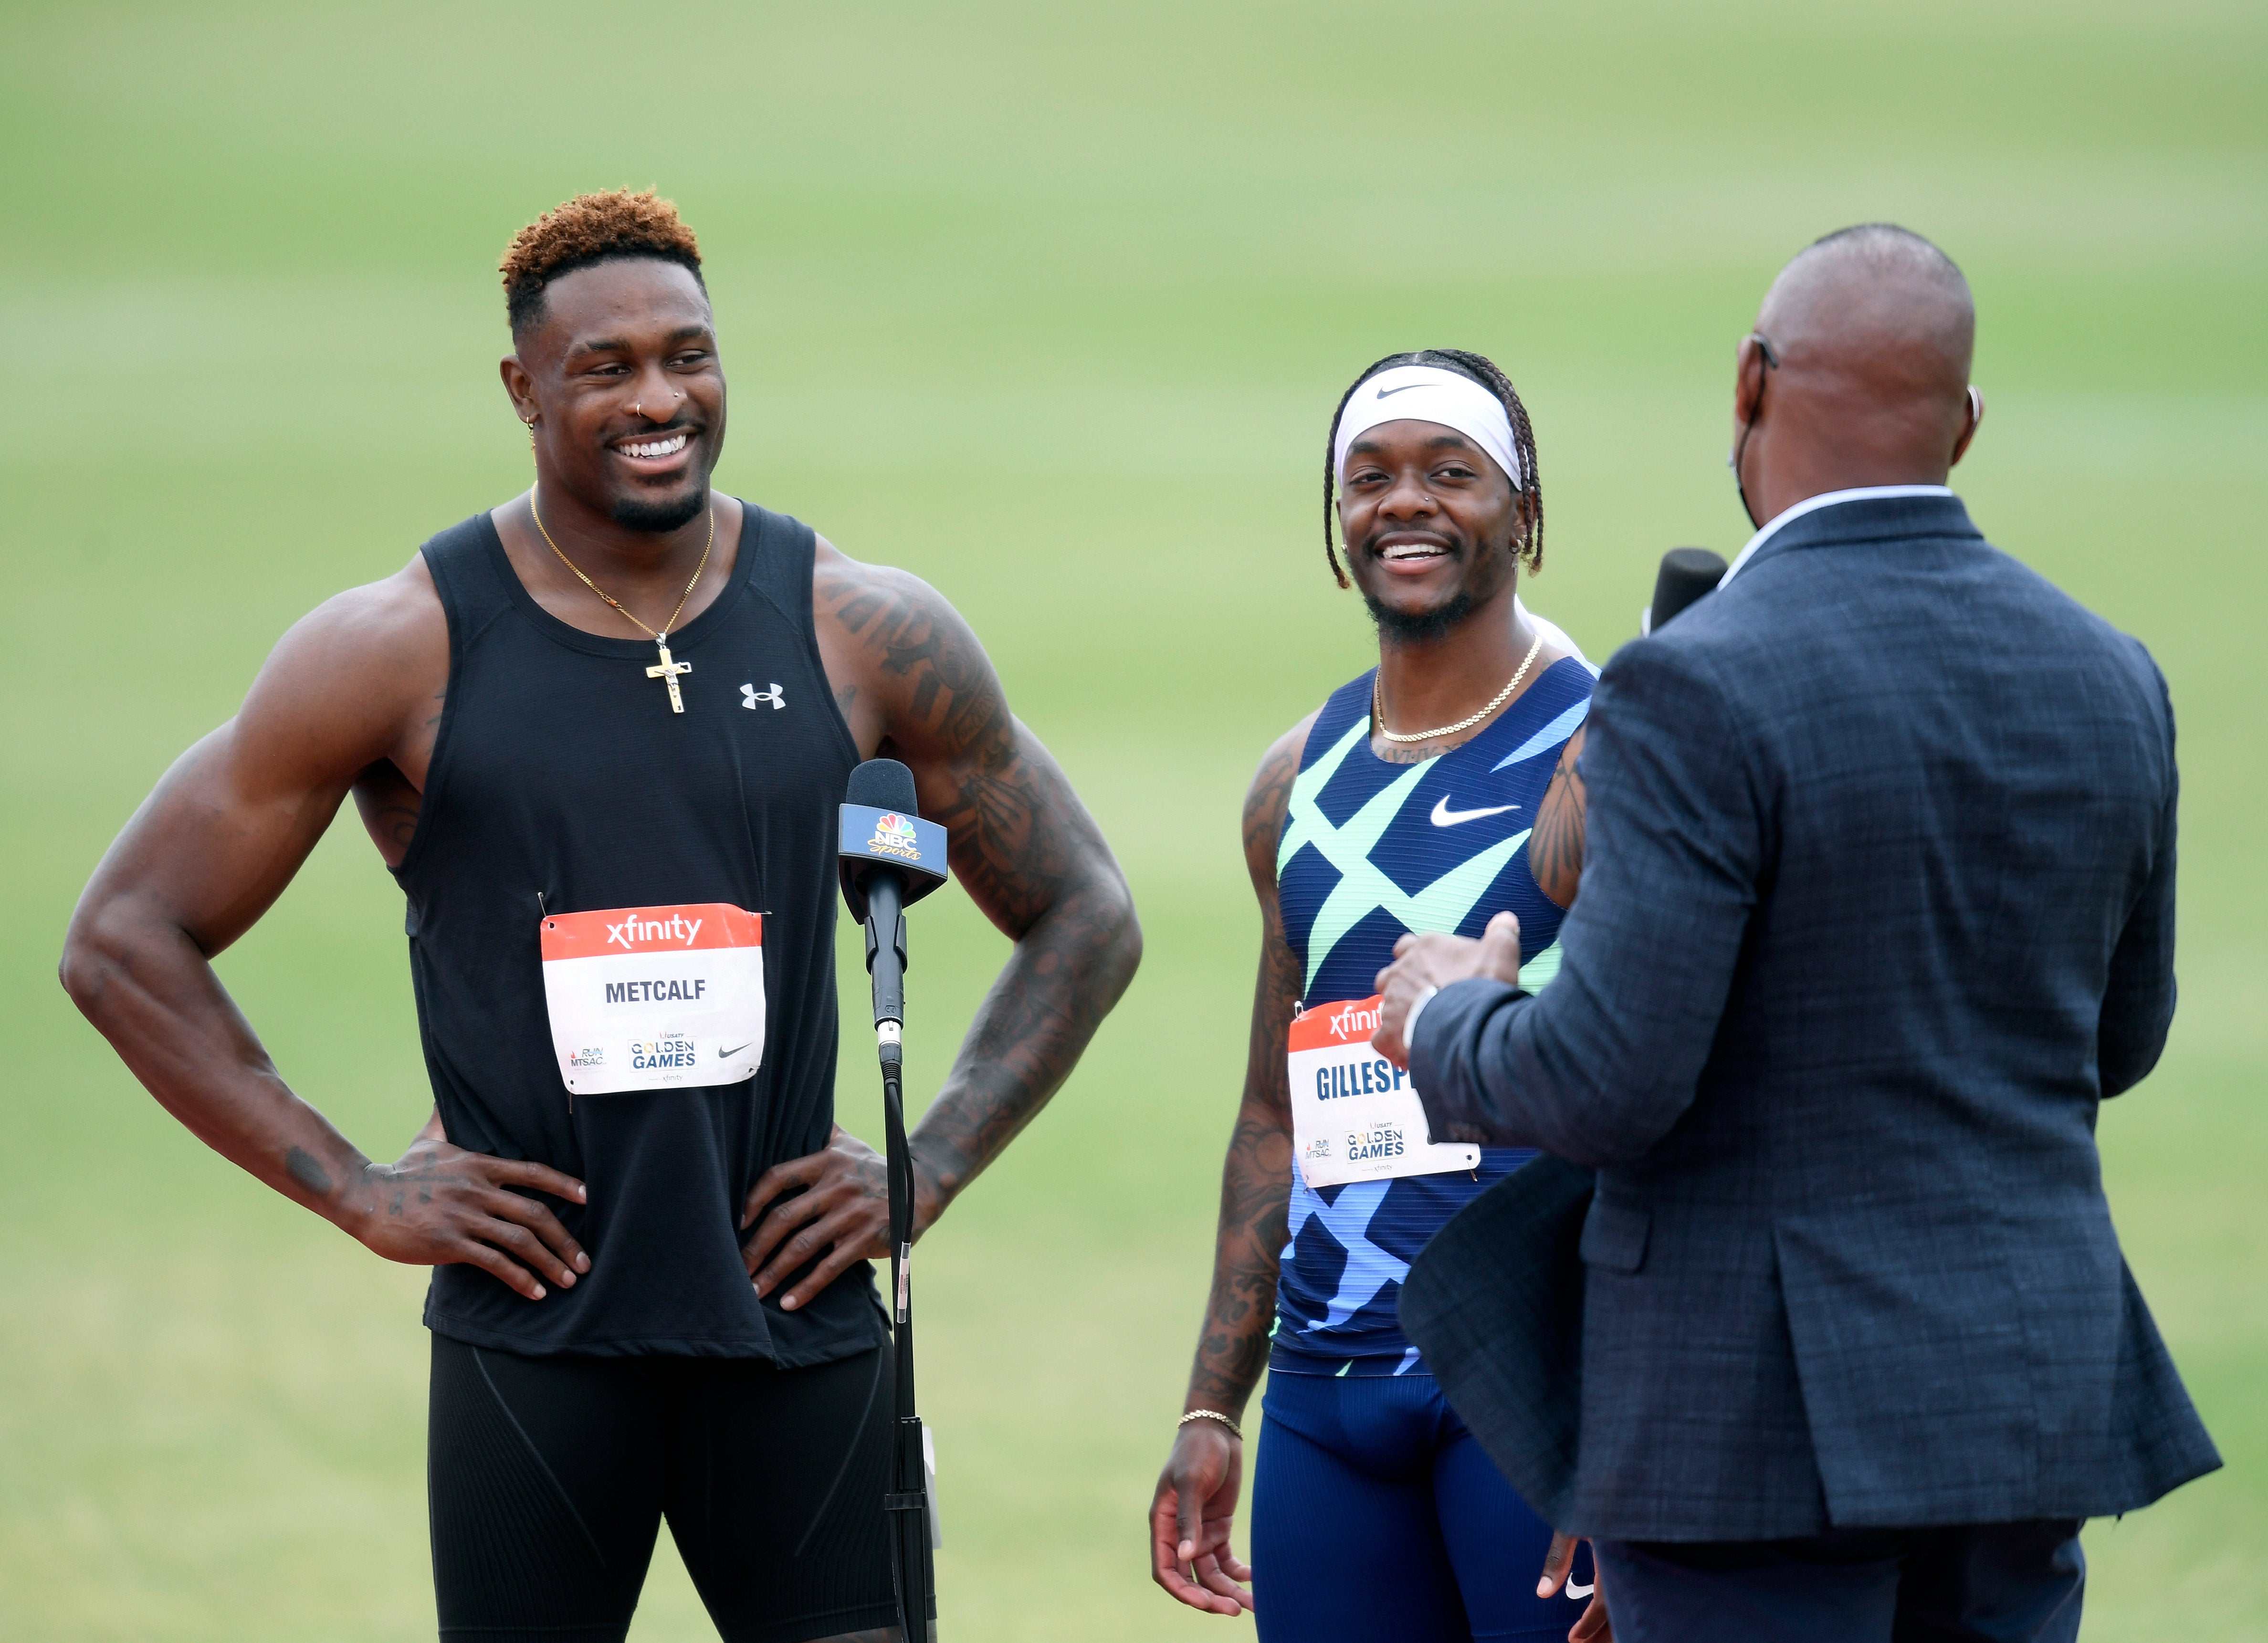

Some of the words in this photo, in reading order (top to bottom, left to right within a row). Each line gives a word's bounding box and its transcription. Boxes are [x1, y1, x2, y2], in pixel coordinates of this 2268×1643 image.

[875, 831, 917, 851] NBC
[867, 839, 922, 860] Sports
[606, 913, 702, 949] xfinity
[605, 980, 705, 1003] METCALF
[582, 1047, 603, 1057] RUN
[631, 1041, 694, 1054] GOLDEN
[571, 1057, 603, 1067] MTSAC
[633, 1053, 695, 1069] GAMES
[1348, 1130, 1402, 1145] GOLDEN
[1306, 1148, 1329, 1159] MTSAC
[1349, 1141, 1404, 1160] GAMES
